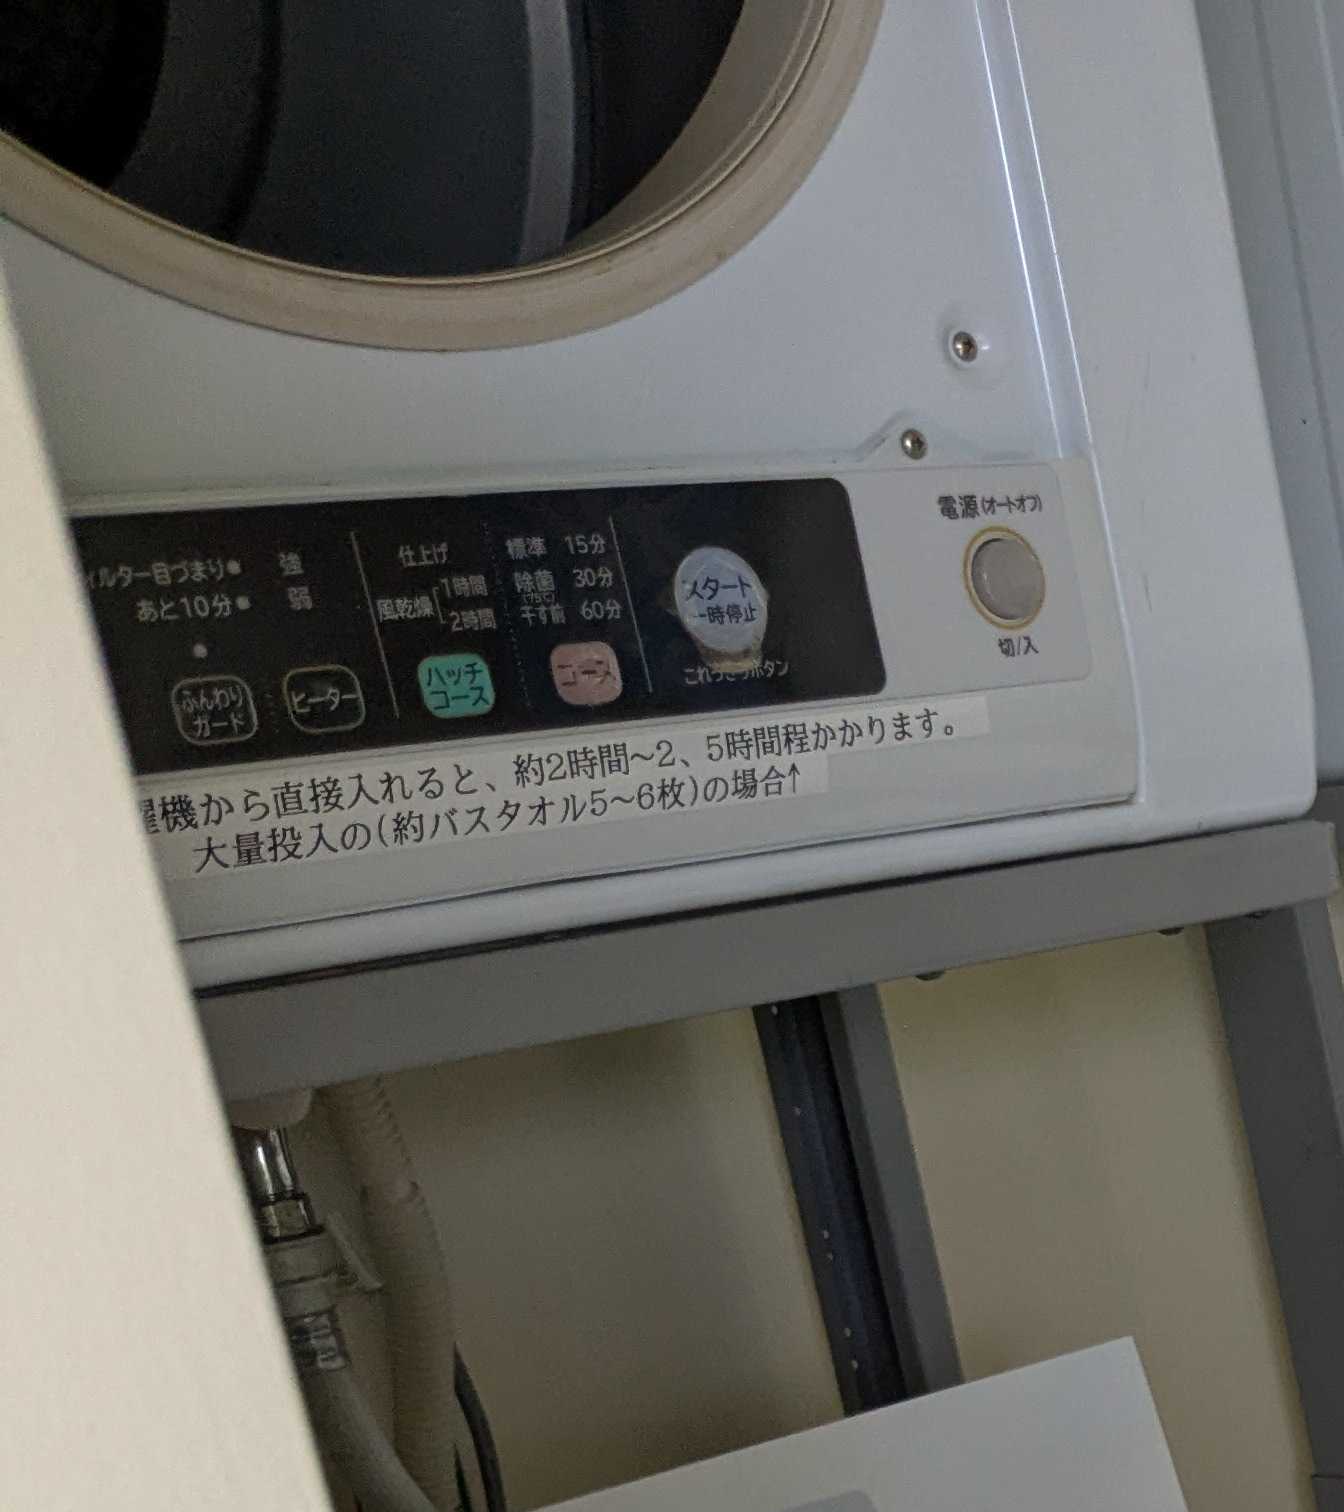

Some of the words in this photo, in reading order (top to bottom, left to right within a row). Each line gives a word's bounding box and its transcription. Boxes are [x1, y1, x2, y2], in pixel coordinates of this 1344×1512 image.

[938, 494, 1043, 521] 電源(オートオフ)
[398, 541, 448, 568] 仕上げ
[505, 536, 547, 561] 標準
[563, 533, 606, 556] 15分
[440, 573, 489, 598] 1時間
[513, 569, 555, 593] 除菌
[572, 566, 614, 589] 30分
[136, 592, 233, 623] あと10分
[376, 595, 435, 623] 風乾燥
[449, 607, 498, 632] 2時間
[519, 604, 567, 627] 干す前
[579, 598, 623, 622] 60分
[693, 603, 757, 626] 一時停止
[998, 636, 1039, 658] 切/入
[426, 660, 484, 688] ハッチ
[556, 659, 617, 688] コース
[174, 684, 244, 714] ふんわり
[290, 685, 360, 713] ヒーター
[430, 685, 491, 711] コース
[192, 711, 245, 738] ガード
